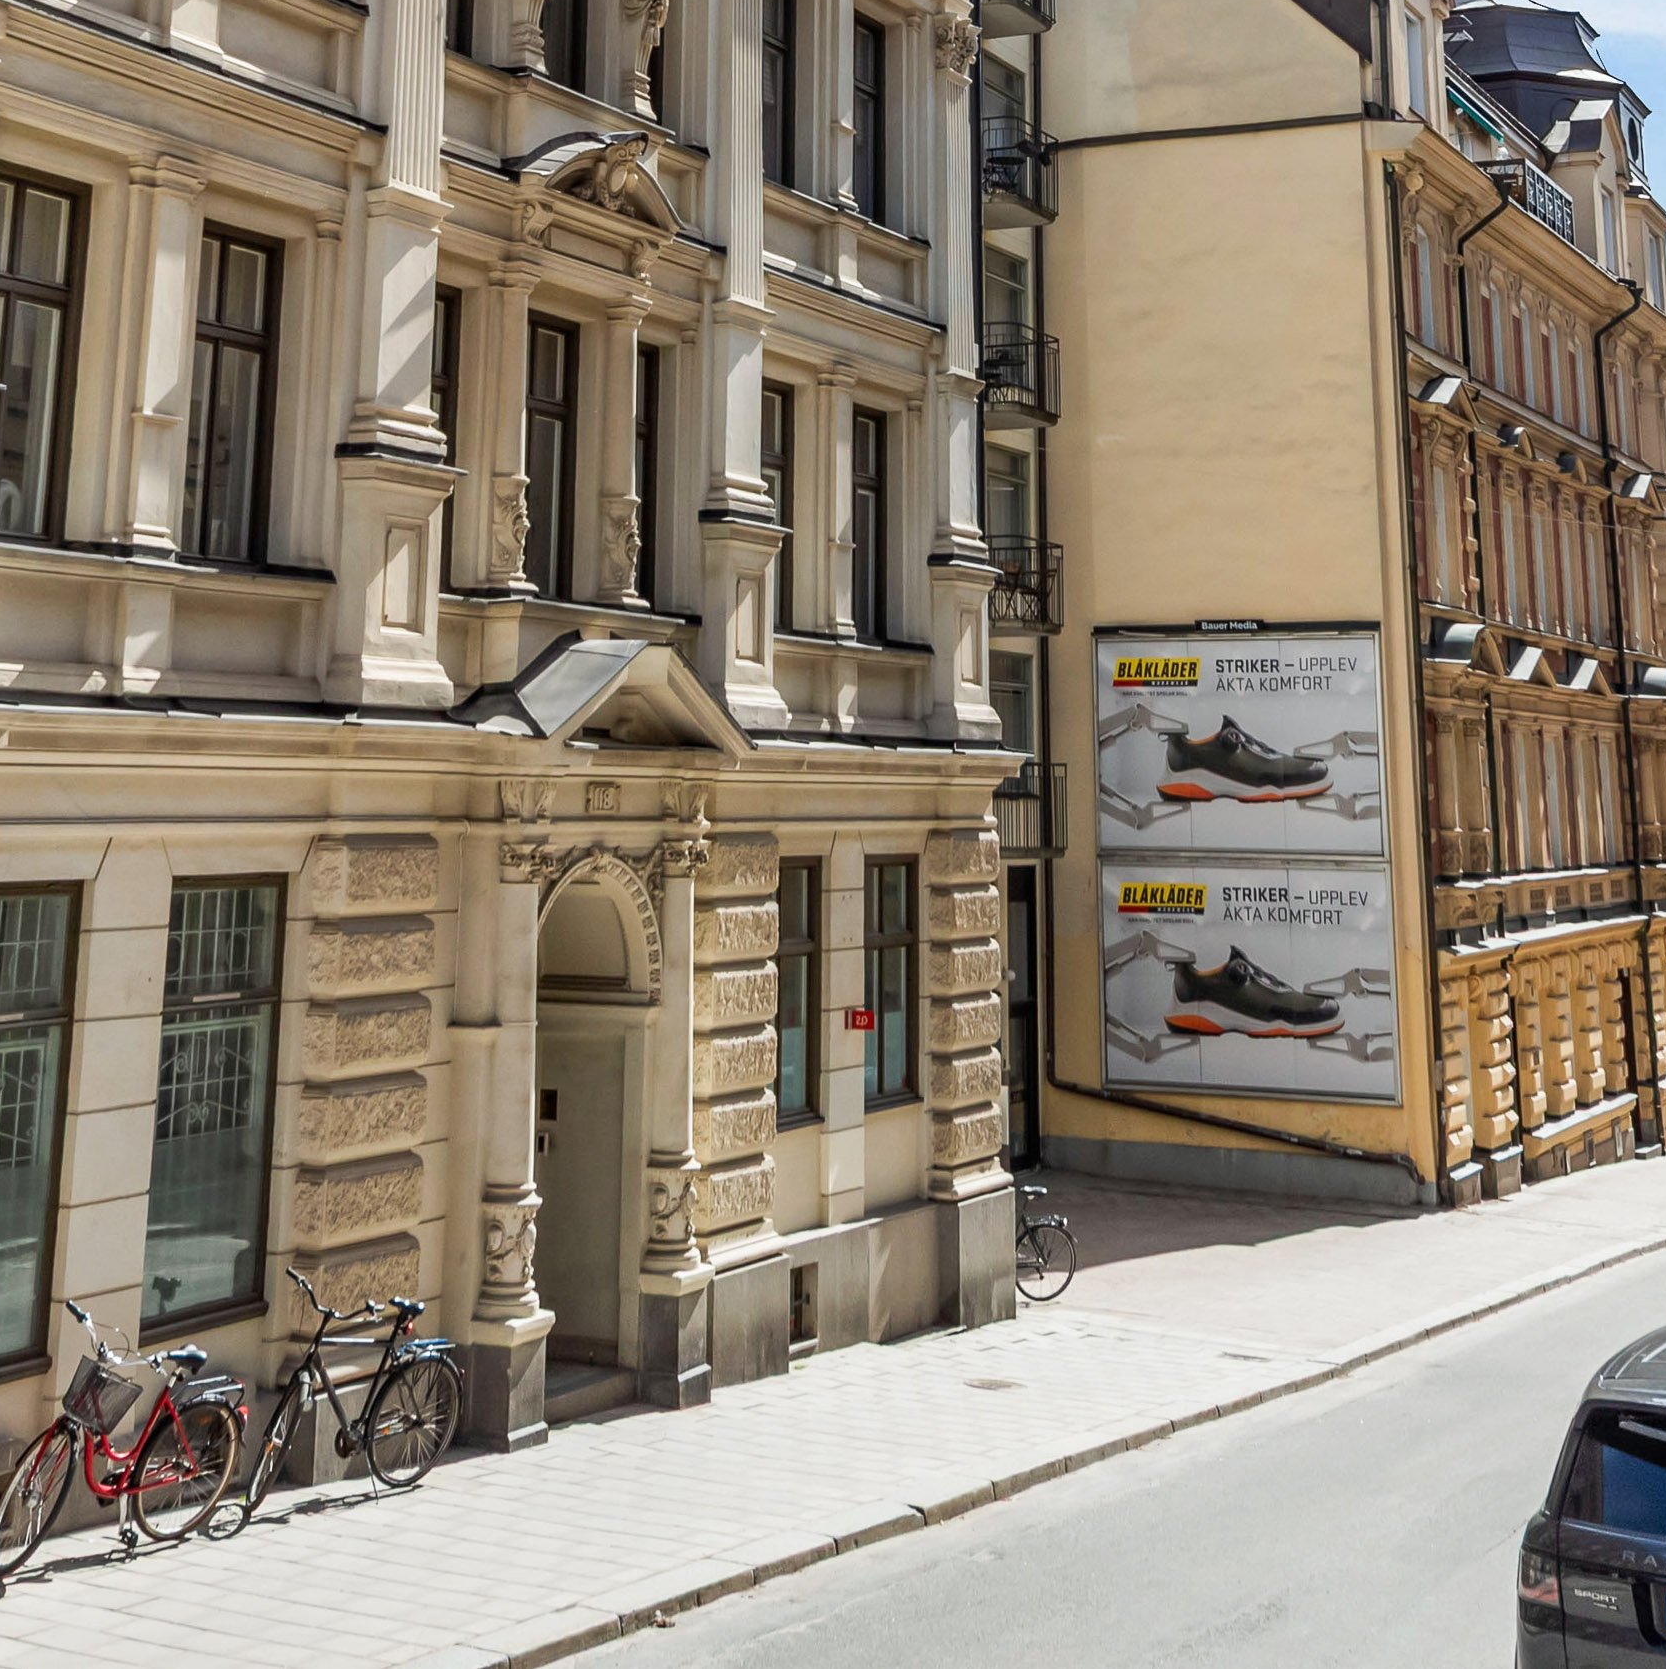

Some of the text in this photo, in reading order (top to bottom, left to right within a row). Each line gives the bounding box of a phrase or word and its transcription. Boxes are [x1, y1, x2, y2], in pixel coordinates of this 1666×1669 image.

[1201, 620, 1258, 630] Bauer Media
[1118, 658, 1197, 678] BLÅKLÄDER
[1216, 659, 1280, 673] STRIKER
[1299, 657, 1358, 672] UPPLEV
[1216, 675, 1333, 692] ÄKTA KOMFORT
[1122, 883, 1204, 906] BLÅKLÄDER
[1222, 887, 1289, 903] STRIKER
[1308, 890, 1369, 906] UPPLEV
[1223, 906, 1343, 925] ÄKTA KOMFORT
[1574, 1588, 1618, 1604] SPORT
